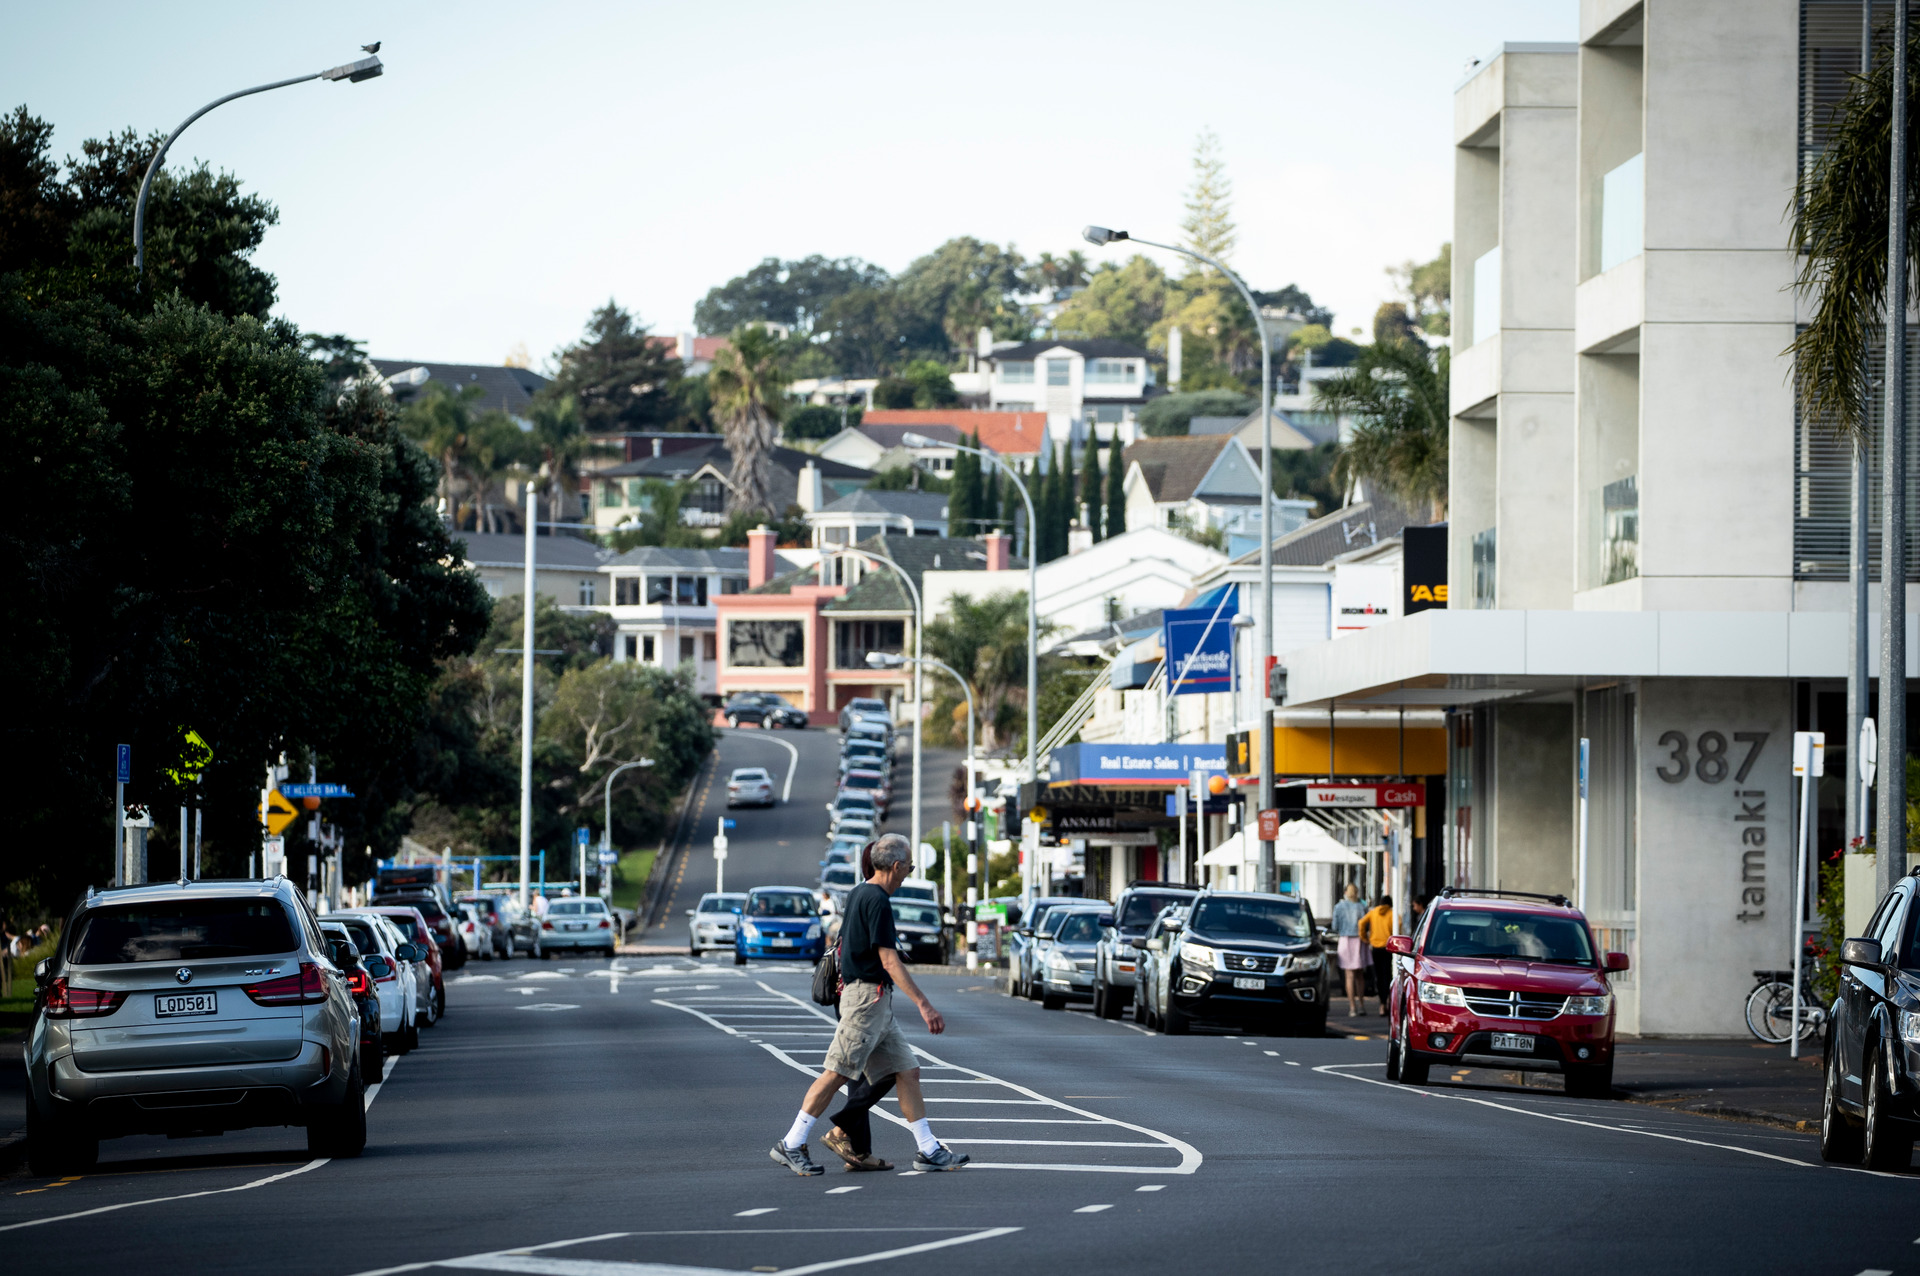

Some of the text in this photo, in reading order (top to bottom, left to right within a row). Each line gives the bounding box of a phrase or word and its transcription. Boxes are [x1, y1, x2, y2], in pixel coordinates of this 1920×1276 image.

[1341, 604, 1388, 615] IRONMAN
[1100, 756, 1179, 770] Real Estate Sales
[1656, 730, 1770, 784] 387
[1318, 793, 1367, 803] Westpac
[1384, 789, 1417, 803] Cash
[1734, 790, 1766, 923] tamaki
[158, 995, 212, 1014] LQD501
